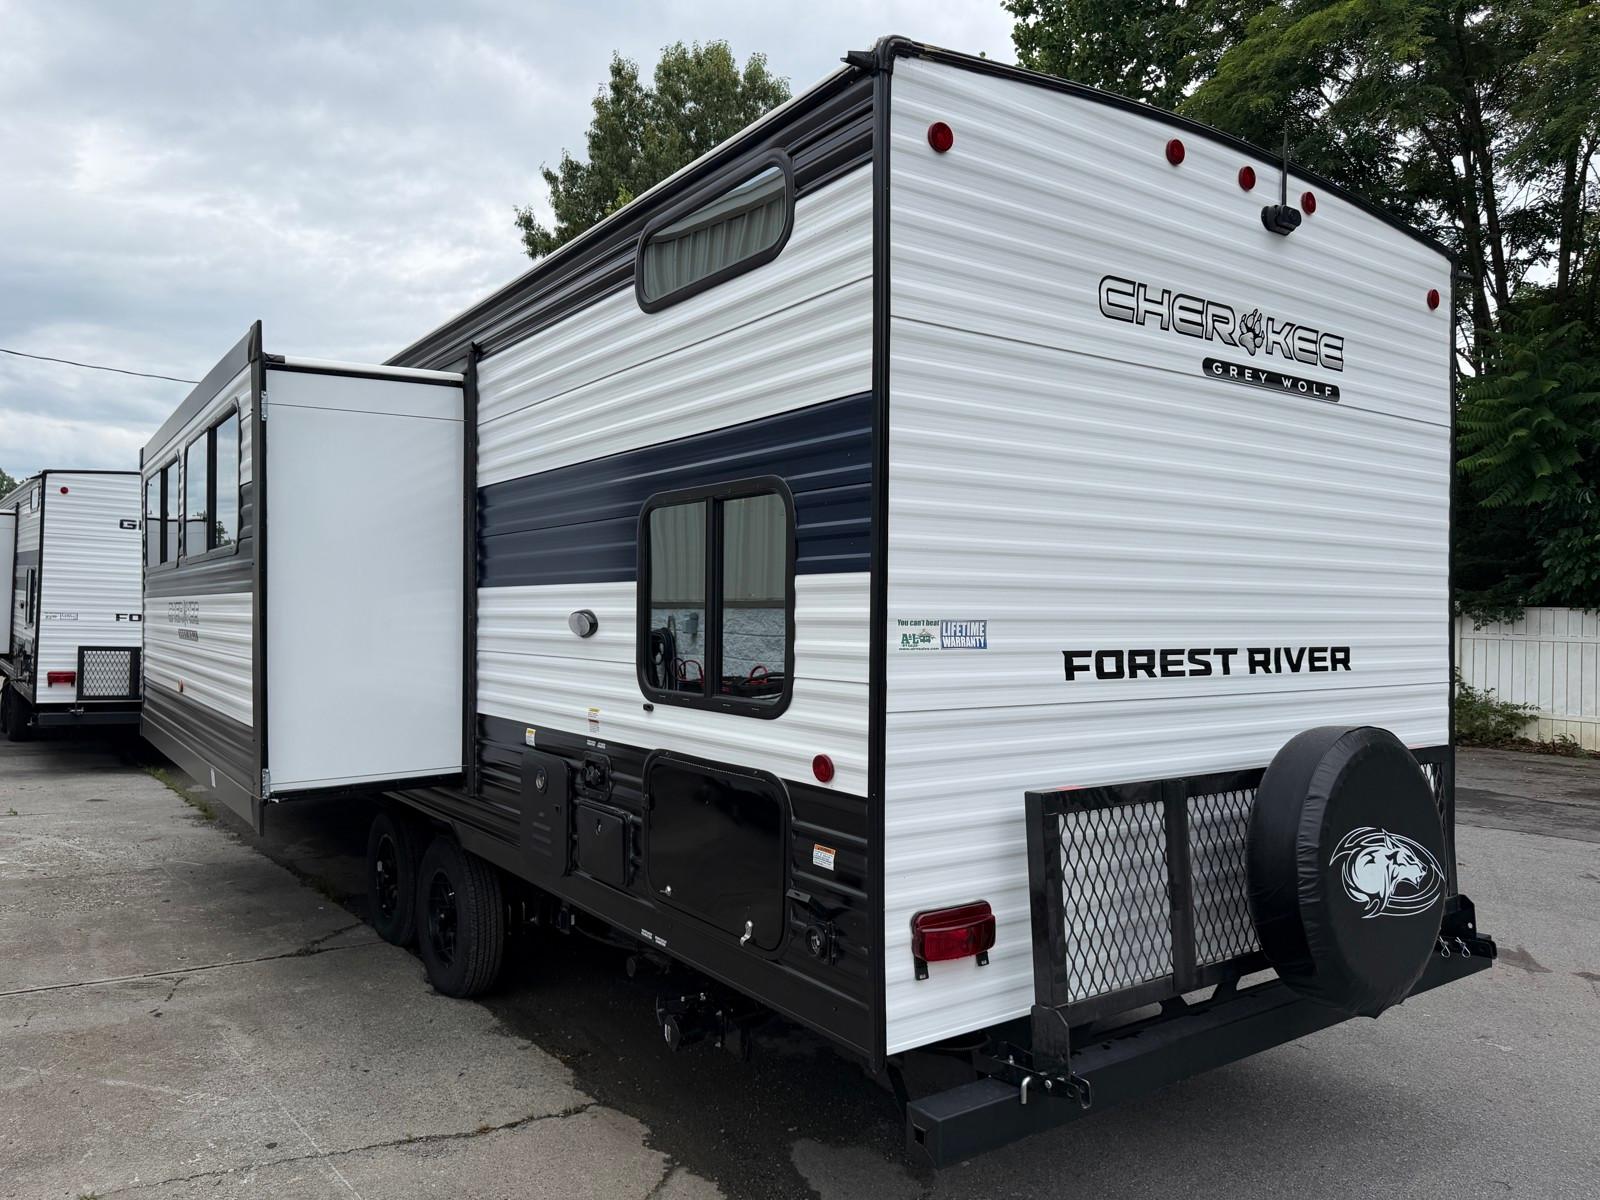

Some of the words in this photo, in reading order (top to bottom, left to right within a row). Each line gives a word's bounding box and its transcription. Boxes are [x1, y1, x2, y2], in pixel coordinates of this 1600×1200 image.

[1212, 362, 1267, 383] GREY
[1281, 377, 1332, 397] WOLF
[897, 618, 909, 626] You
[942, 621, 985, 636] LIFETIME
[942, 636, 985, 648] WARRANTY
[1062, 648, 1238, 681] FOREST
[1246, 646, 1352, 674] RIVER
